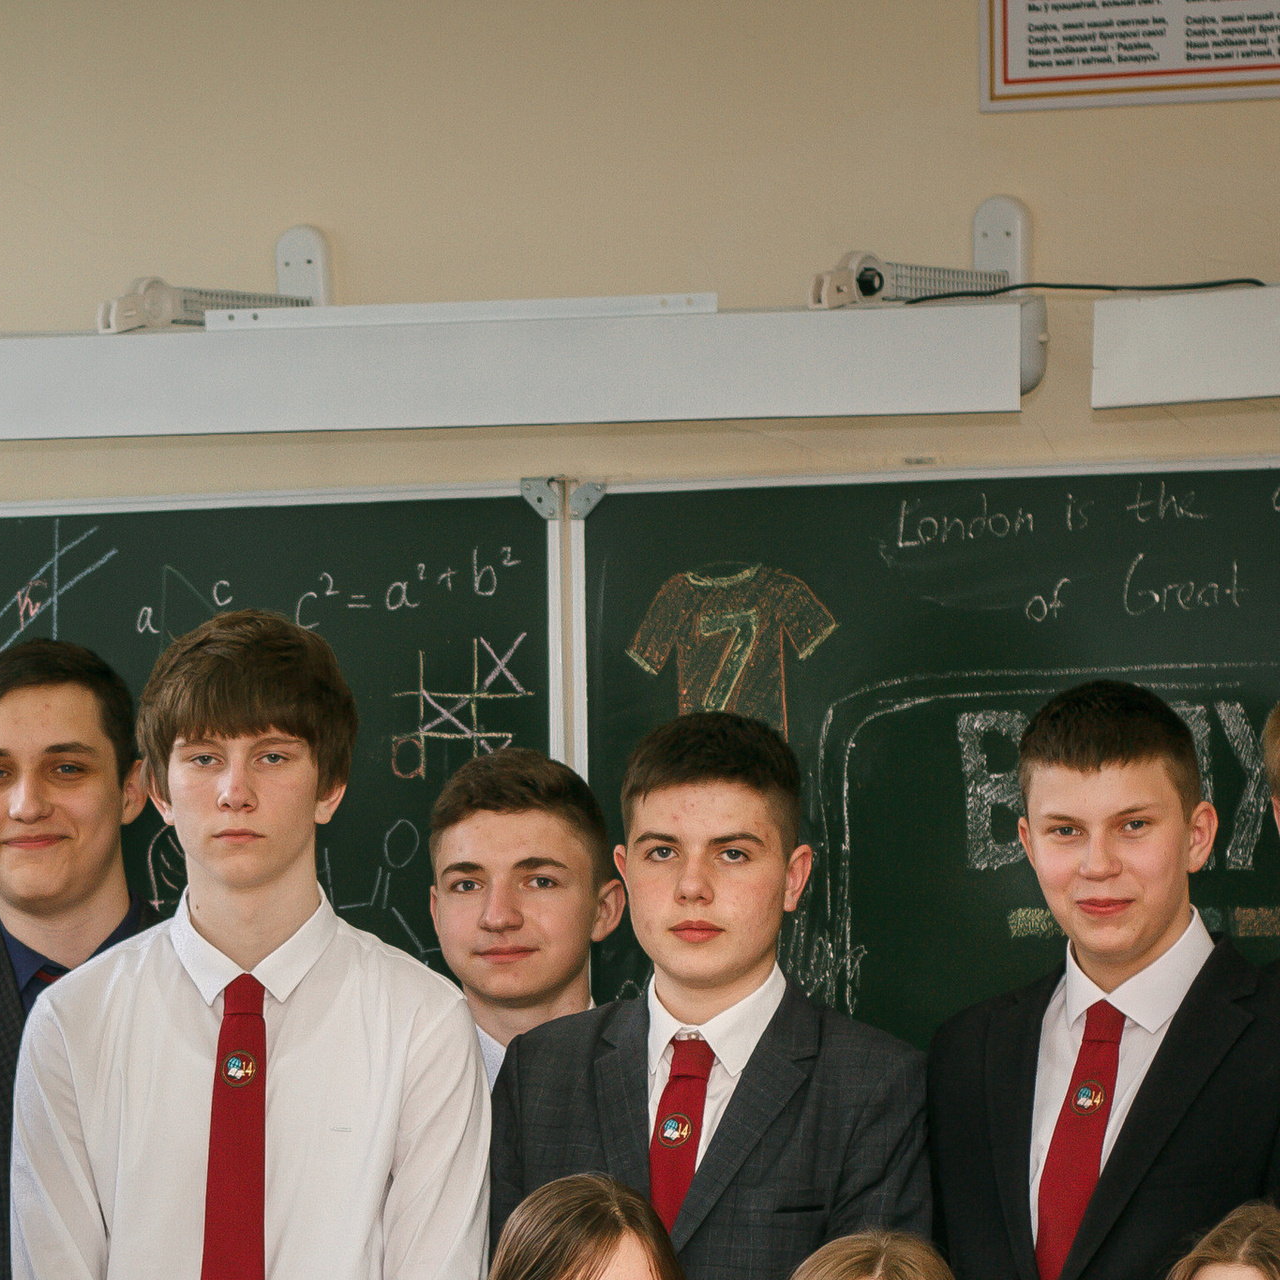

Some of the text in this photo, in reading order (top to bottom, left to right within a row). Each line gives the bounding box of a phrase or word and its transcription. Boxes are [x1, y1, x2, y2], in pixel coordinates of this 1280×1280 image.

[896, 493, 1033, 547] London
[1067, 493, 1090, 531] is
[1126, 481, 1210, 522] the
[1026, 553, 1247, 622] of Great
[700, 609, 759, 713] 7
[242, 1061, 255, 1077] 14
[1091, 1090, 1104, 1107] 14
[677, 1122, 689, 1139] 14
